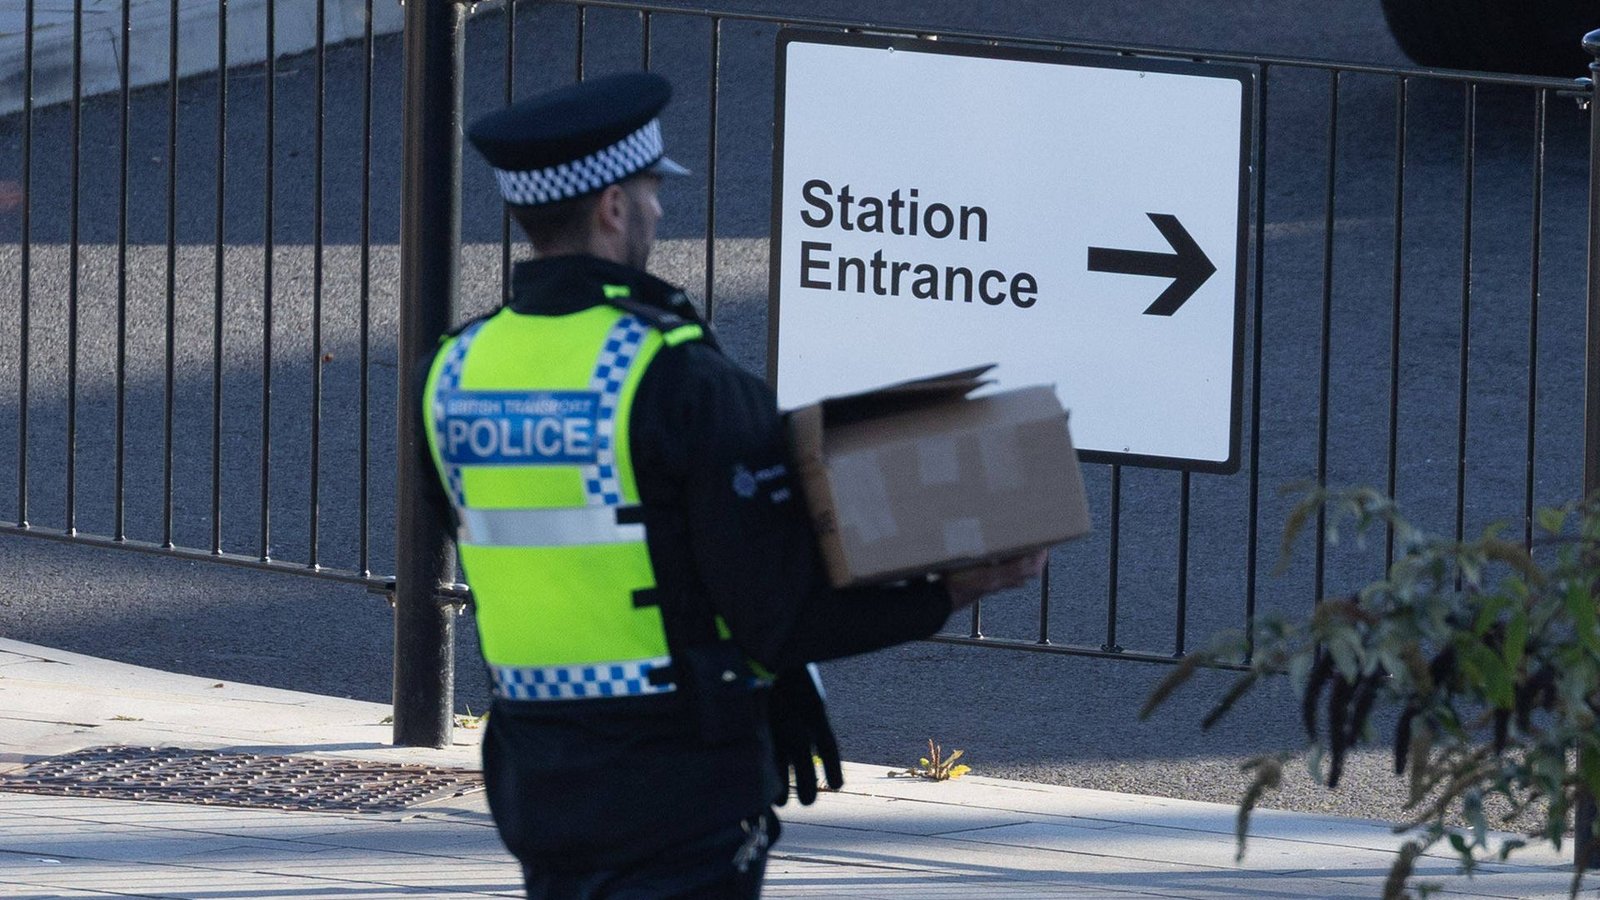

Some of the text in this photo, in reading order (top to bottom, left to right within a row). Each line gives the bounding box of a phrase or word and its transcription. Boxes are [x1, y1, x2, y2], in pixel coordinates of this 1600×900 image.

[800, 179, 987, 242] Station
[800, 240, 1038, 308] Entrance
[449, 417, 592, 457] POLICE
